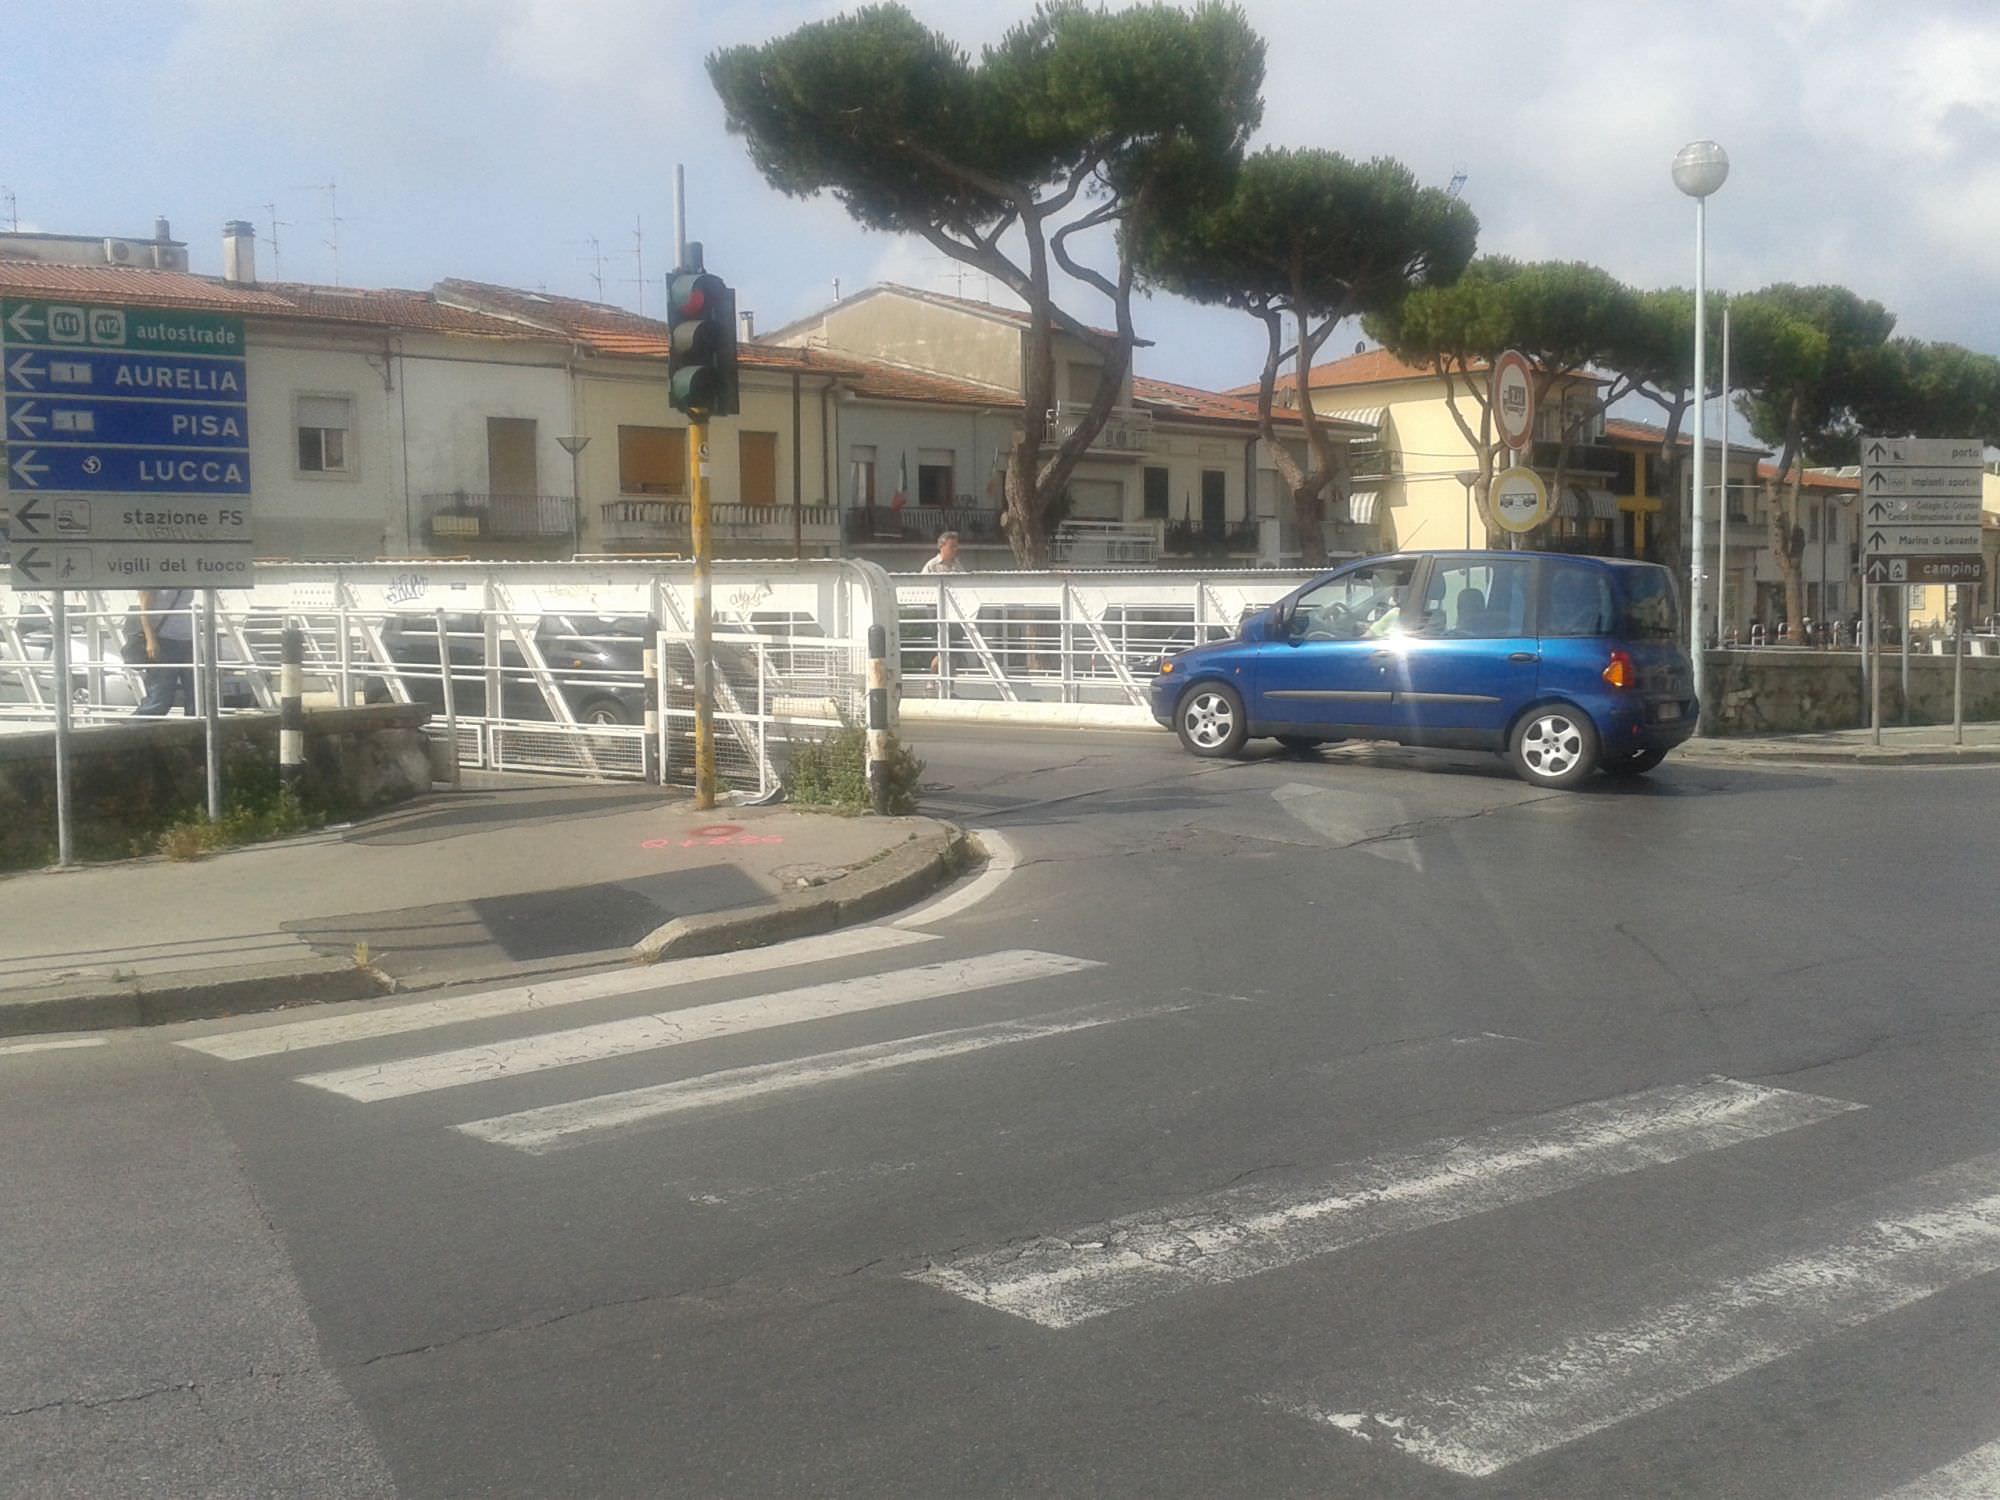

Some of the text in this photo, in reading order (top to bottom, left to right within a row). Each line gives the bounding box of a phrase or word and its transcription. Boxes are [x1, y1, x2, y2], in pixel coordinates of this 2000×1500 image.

[55, 316, 236, 344] A11 A12 autostrade
[115, 364, 238, 391] AURELIA
[172, 413, 240, 437] PISA
[139, 460, 243, 483] LUCCA
[123, 510, 244, 526] stazione FS
[107, 557, 246, 576] vigili del fuoco
[1923, 560, 1981, 577] camping
